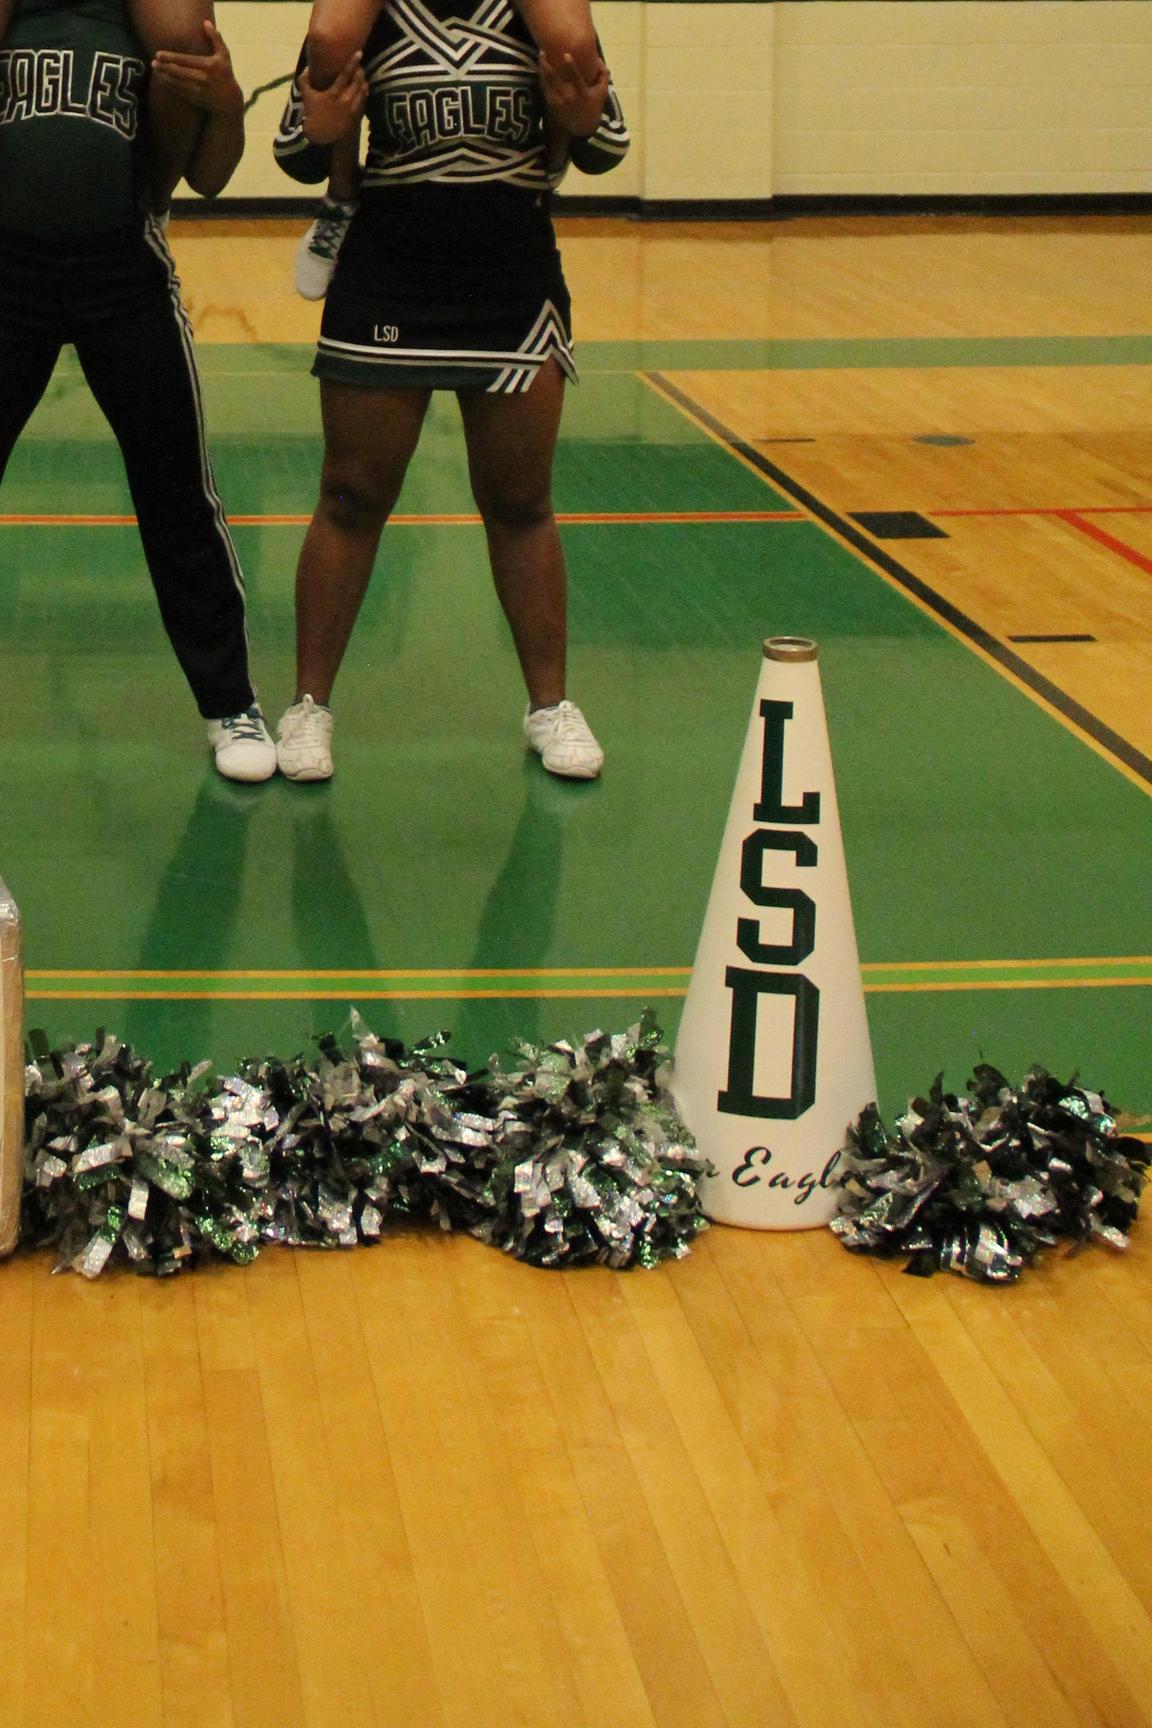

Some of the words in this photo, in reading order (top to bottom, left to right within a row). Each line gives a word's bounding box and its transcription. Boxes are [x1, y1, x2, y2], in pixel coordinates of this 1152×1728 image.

[385, 86, 532, 157] EAGLES
[373, 324, 399, 343] LSD
[717, 698, 821, 1120] LSD
